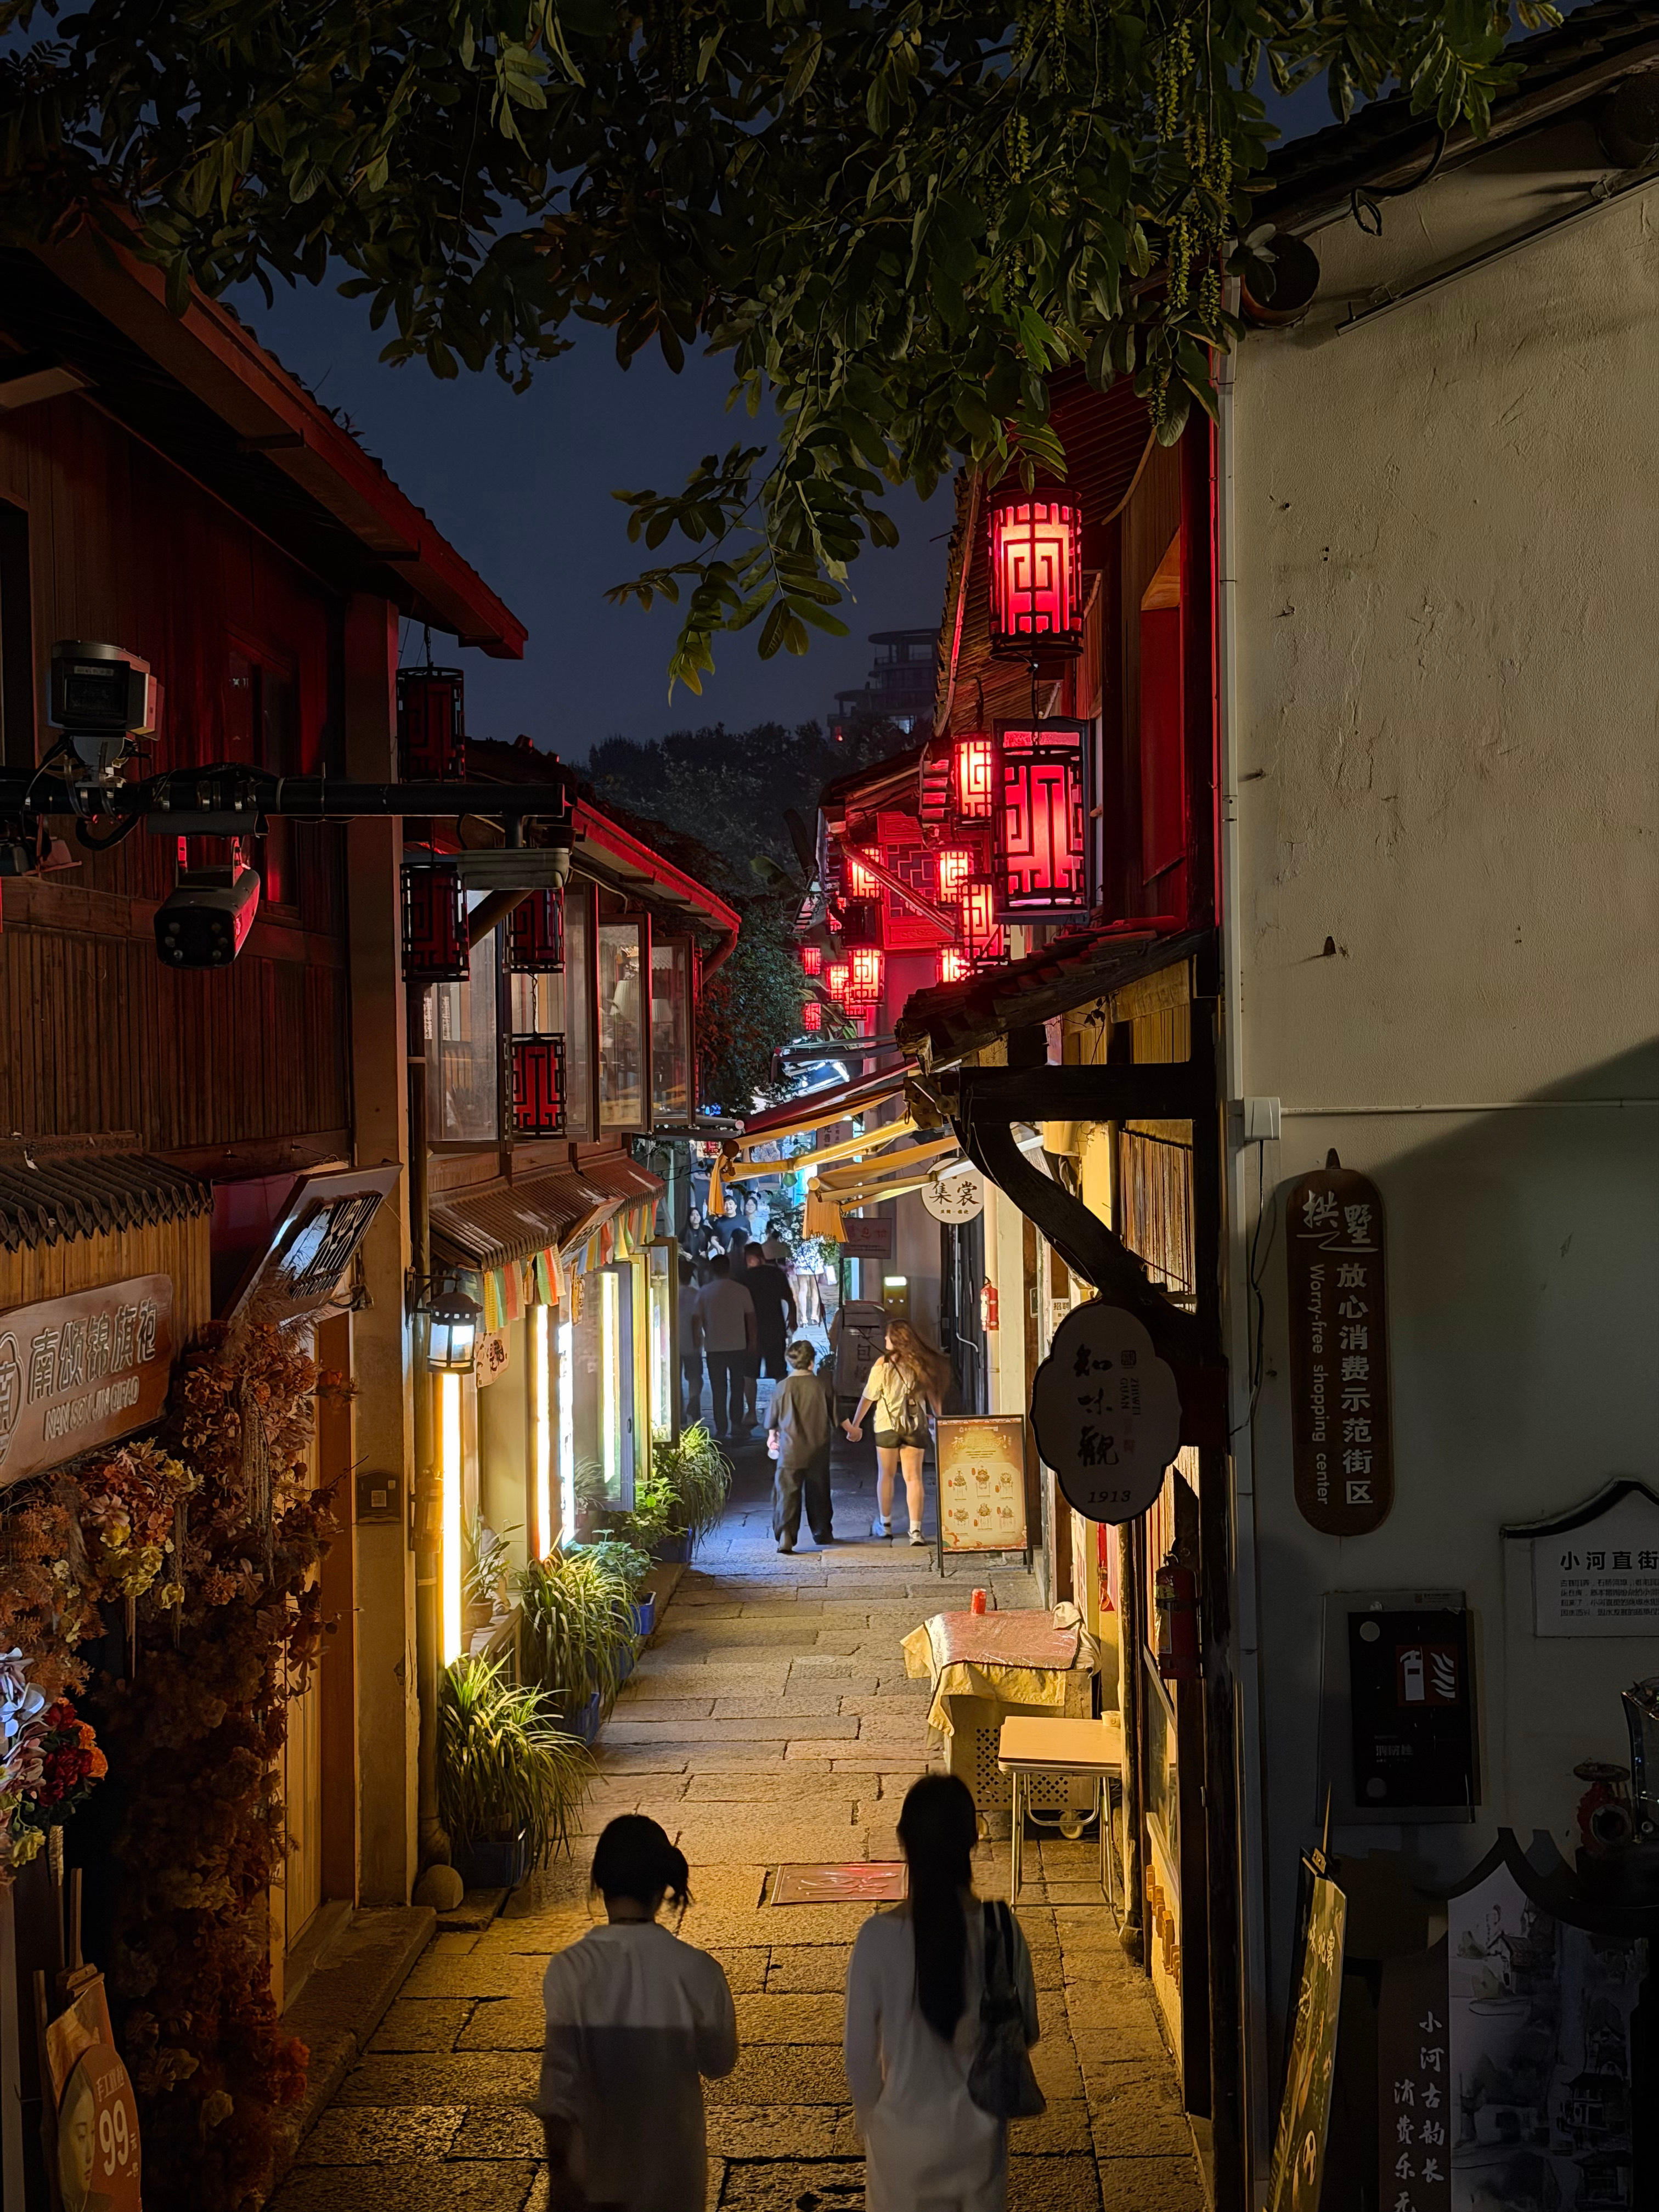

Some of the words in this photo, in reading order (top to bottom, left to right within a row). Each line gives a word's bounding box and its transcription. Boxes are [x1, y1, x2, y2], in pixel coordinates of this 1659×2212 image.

[1302, 1189, 1373, 1244] 拱墅
[1309, 1263, 1327, 1354] Worry-free
[28, 1297, 157, 1404] 南颂锦旗袍
[1336, 1262, 1374, 1505] 放心消费示范街区
[43, 1402, 71, 1442] NAN
[1311, 1364, 1327, 1442] shopping
[1087, 1490, 1131, 1504] 1913
[1315, 1453, 1328, 1505] center
[1560, 1550, 1659, 1571] 小河直街
[1419, 2011, 1444, 2183] 小河古韵长
[99, 2099, 129, 2176] 99
